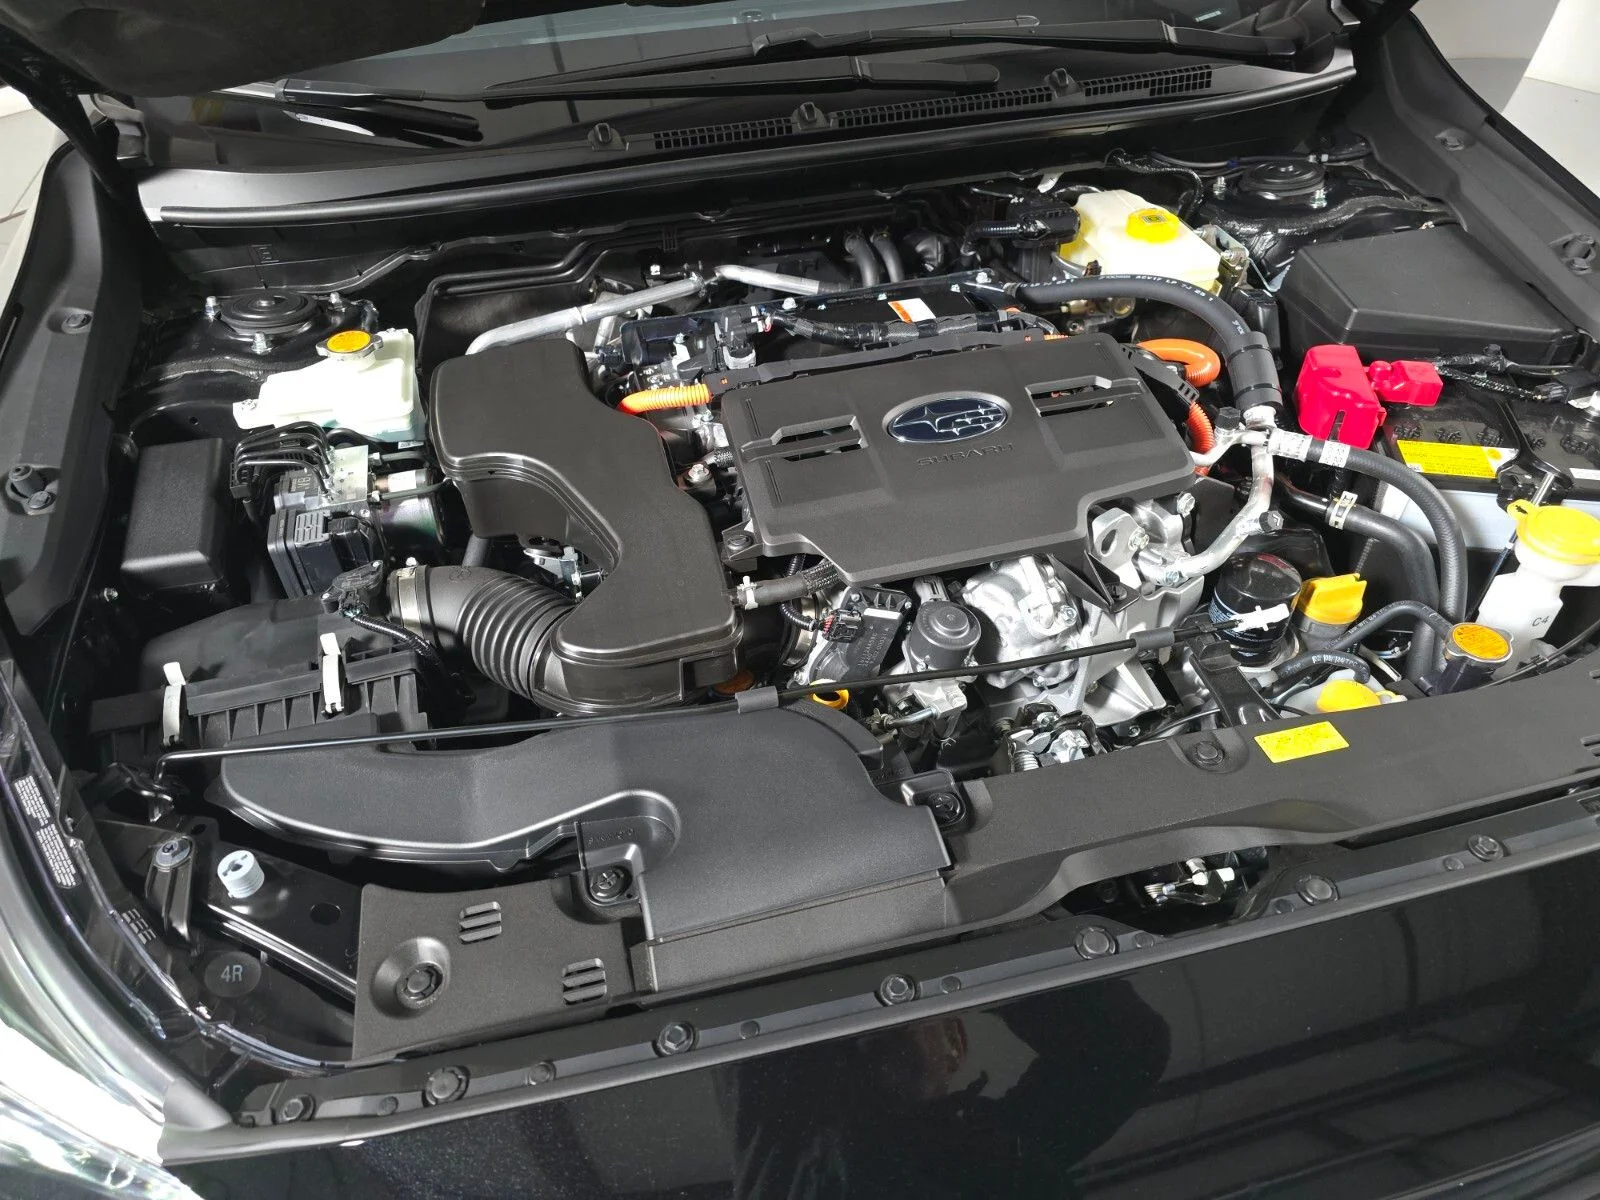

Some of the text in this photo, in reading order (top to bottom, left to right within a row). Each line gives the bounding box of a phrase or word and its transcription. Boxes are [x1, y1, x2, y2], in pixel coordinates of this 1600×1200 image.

[917, 442, 1014, 466] SUBARU
[1531, 615, 1550, 627] C4
[220, 964, 243, 982] 4R
